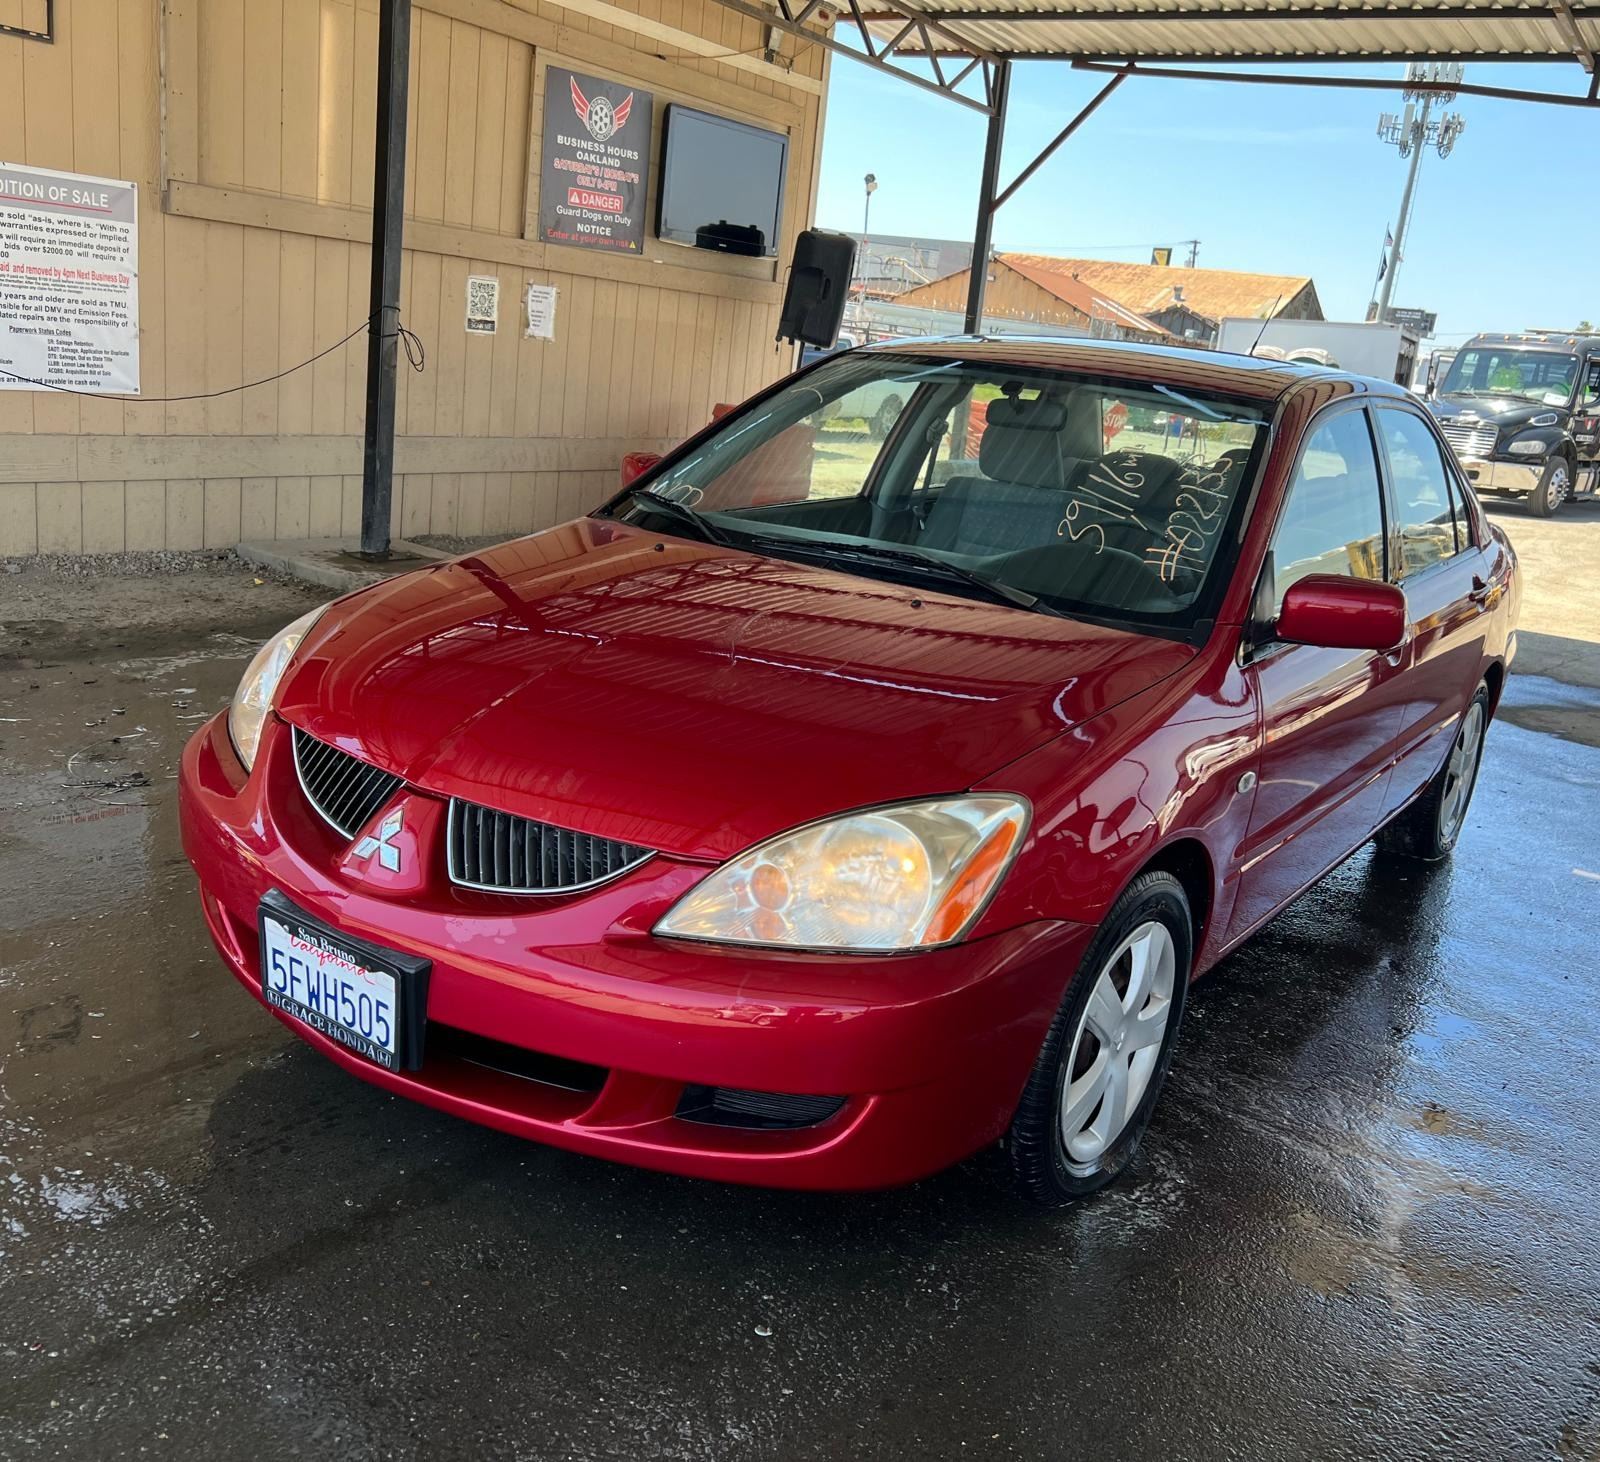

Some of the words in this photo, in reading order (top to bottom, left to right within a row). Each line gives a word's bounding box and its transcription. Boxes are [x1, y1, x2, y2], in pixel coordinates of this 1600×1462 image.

[557, 135, 605, 153] BUSINESS
[607, 145, 639, 160] HOURS
[576, 151, 620, 168] OAKLAND
[577, 174, 597, 188] ONLY
[48, 186, 68, 201] OF
[72, 189, 109, 208] SALE
[581, 193, 621, 210] DANGER
[7, 213, 25, 221] sold
[57, 218, 81, 228] where
[556, 205, 582, 217] Guard
[582, 209, 602, 222] Dogs
[603, 213, 613, 222] on
[615, 215, 632, 227] Duty
[46, 226, 87, 238] expressed
[547, 228, 569, 239] Enter
[576, 222, 612, 236] NOTICE
[4, 242, 21, 250] bids
[42, 246, 73, 256] $2000.00
[92, 253, 116, 261] require
[20, 235, 46, 244] require
[58, 239, 94, 250] immediate
[96, 244, 121, 253] deposit
[13, 264, 25, 273] and
[26, 264, 53, 276] removed
[54, 267, 61, 280] by
[63, 268, 75, 279] 4pm
[77, 269, 90, 281] Next
[91, 270, 117, 283] Business
[119, 273, 129, 286] Day
[4, 292, 27, 300] years
[28, 294, 43, 302] and
[45, 295, 65, 304] older
[22, 303, 32, 311] for
[45, 305, 62, 314] DMV
[64, 307, 76, 315] and
[78, 308, 110, 317] Emission
[20, 313, 45, 321] repairs
[74, 318, 120, 329] responsibility
[121, 320, 129, 328] of
[9, 325, 37, 335] Paperwork
[38, 327, 55, 336] Status
[56, 328, 72, 337] Codes
[298, 926, 318, 947] San
[319, 936, 356, 964] Bruno
[271, 947, 390, 1049] 5FWH505
[281, 998, 325, 1032] GRACE
[327, 1021, 375, 1058] HONDA
